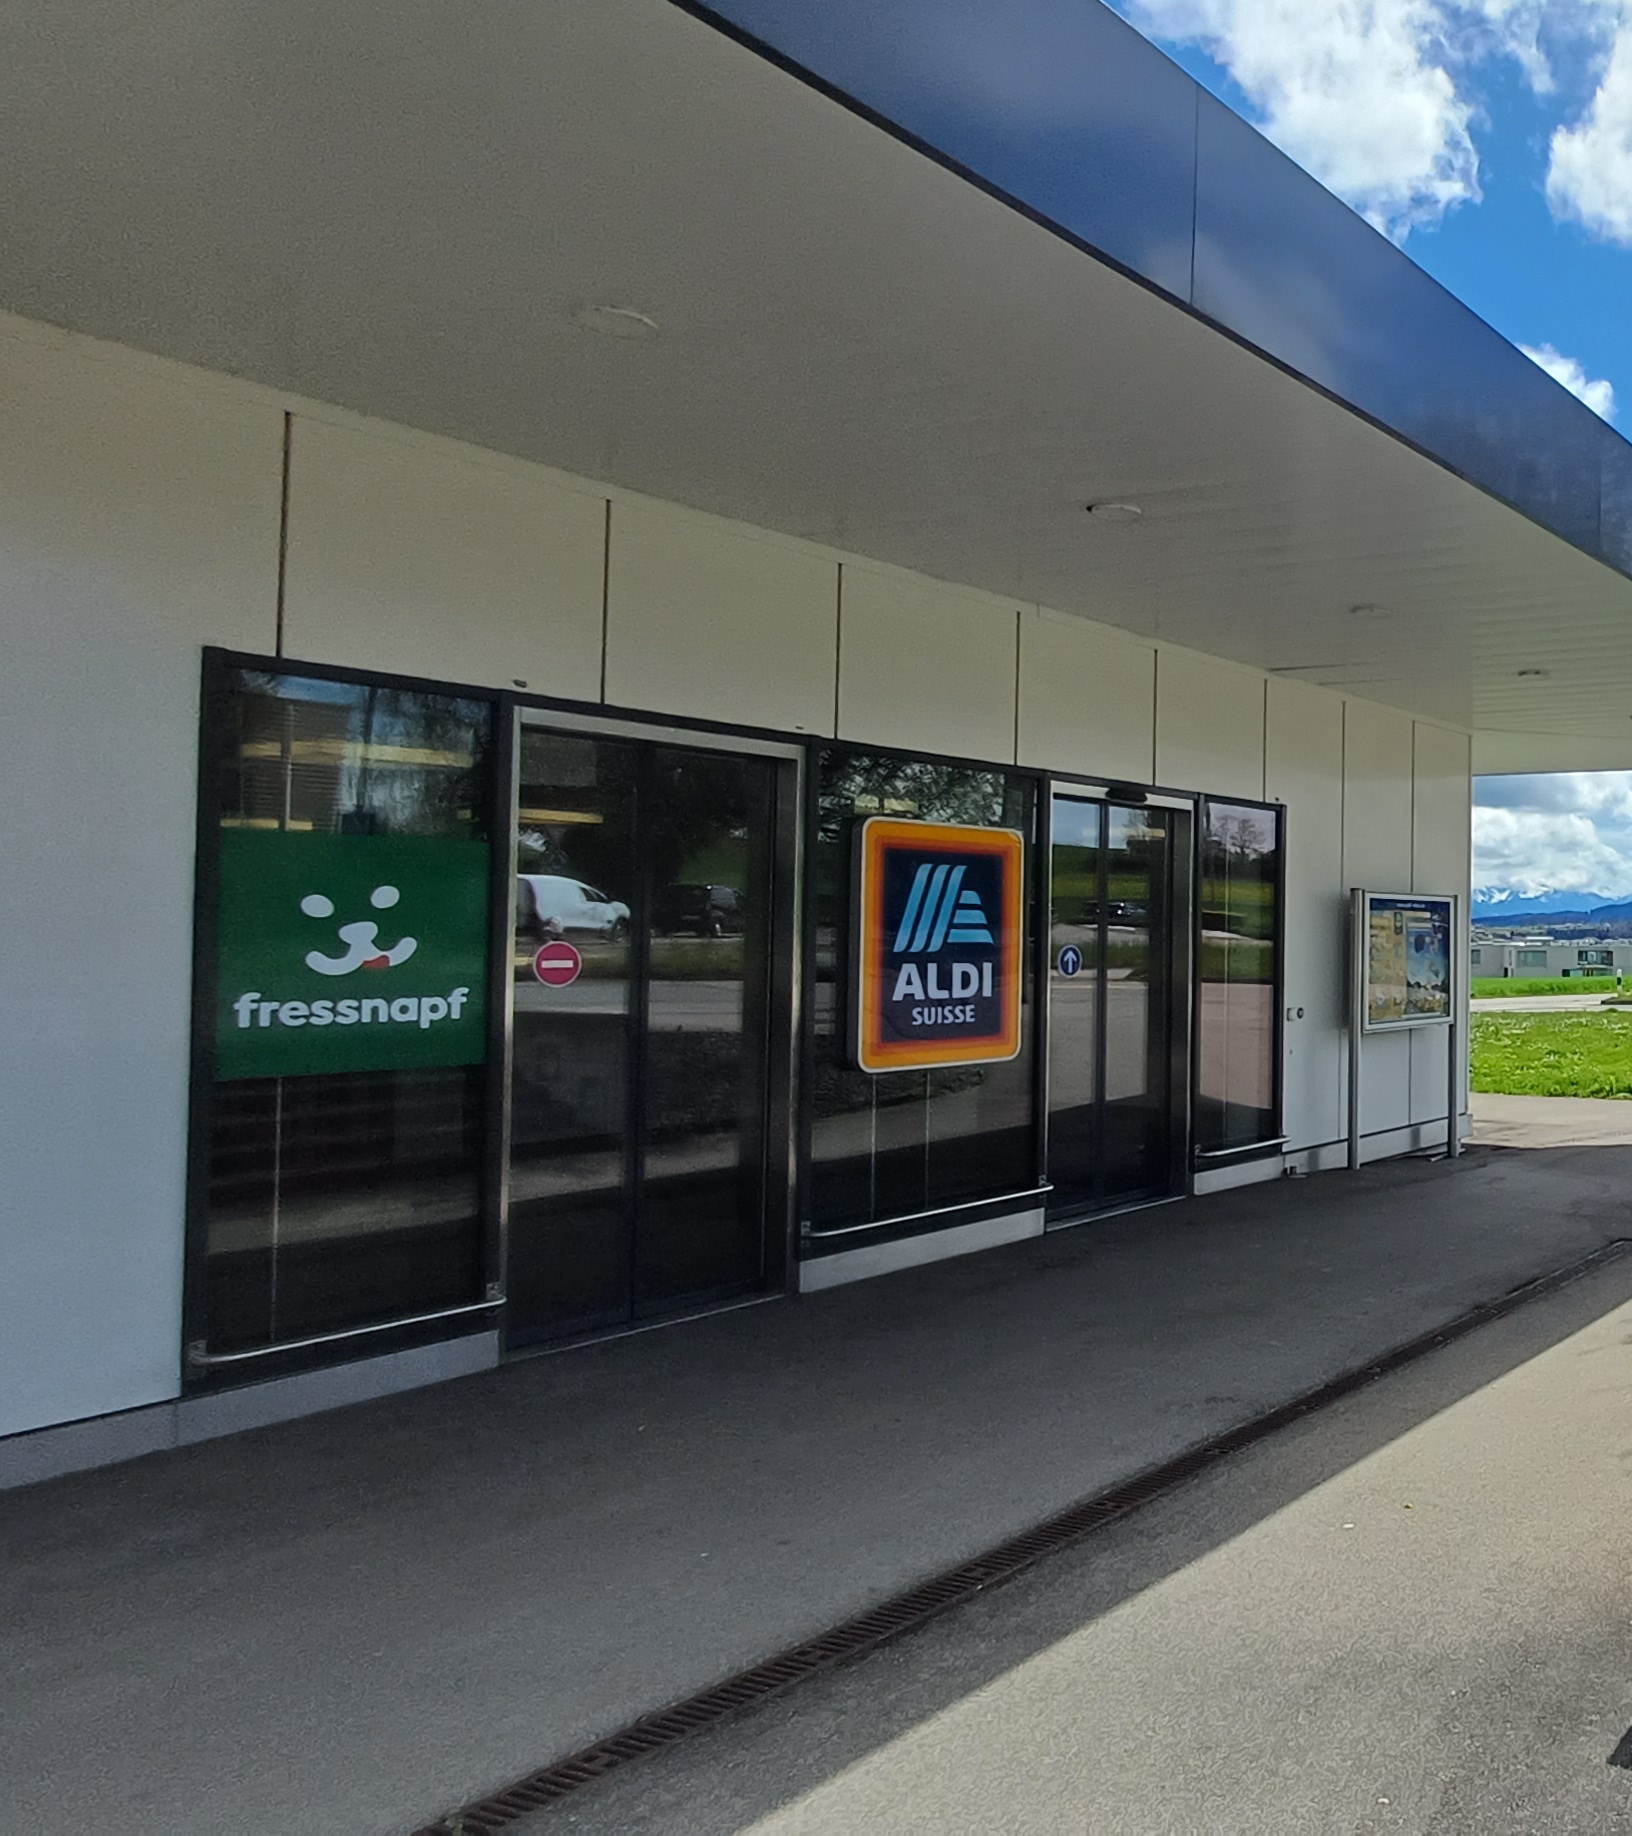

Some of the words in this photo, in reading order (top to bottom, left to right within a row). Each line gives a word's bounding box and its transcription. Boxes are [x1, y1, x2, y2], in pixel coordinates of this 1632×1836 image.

[892, 962, 992, 1001] ALDI
[233, 987, 470, 1029] fressnapf
[912, 1004, 976, 1026] SUISSE
